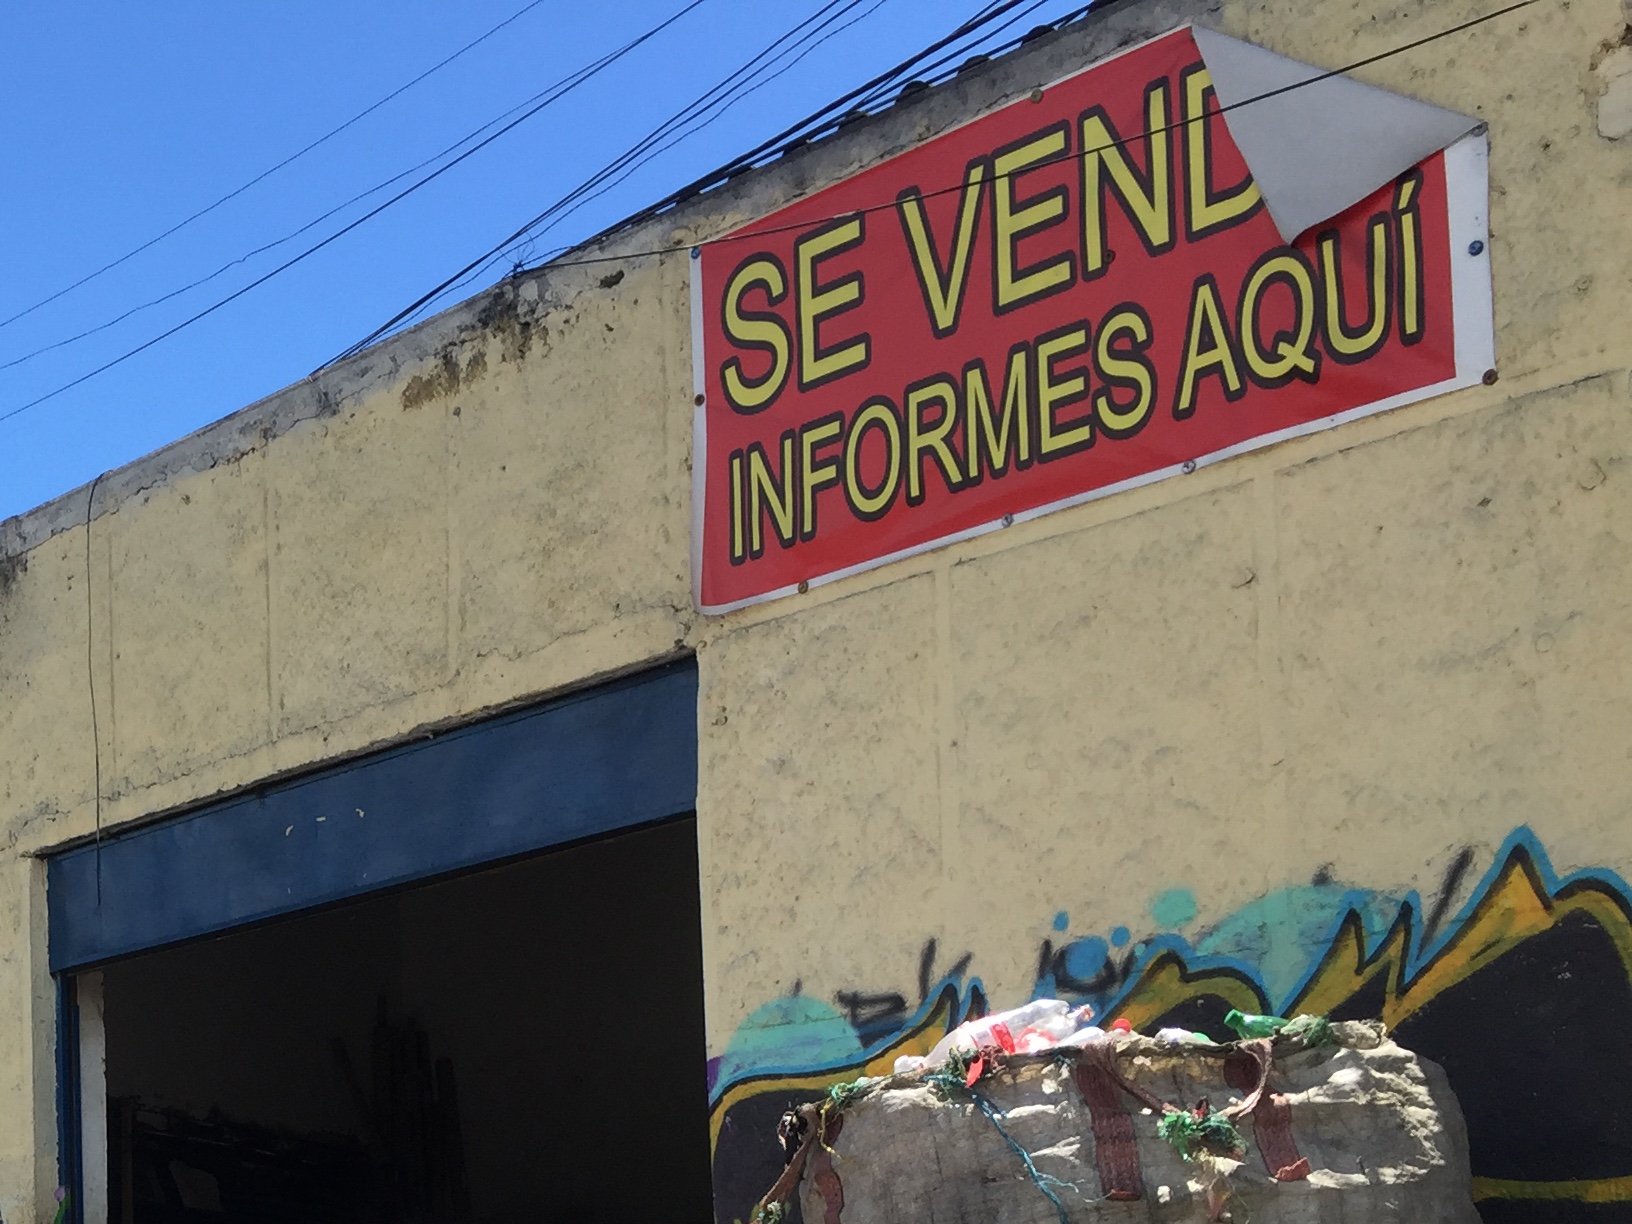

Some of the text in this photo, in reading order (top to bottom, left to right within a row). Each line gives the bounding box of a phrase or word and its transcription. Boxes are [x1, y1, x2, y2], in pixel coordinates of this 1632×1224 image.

[720, 61, 1266, 416] SE VEND
[729, 168, 1425, 566] INFORMES AQUÍ
